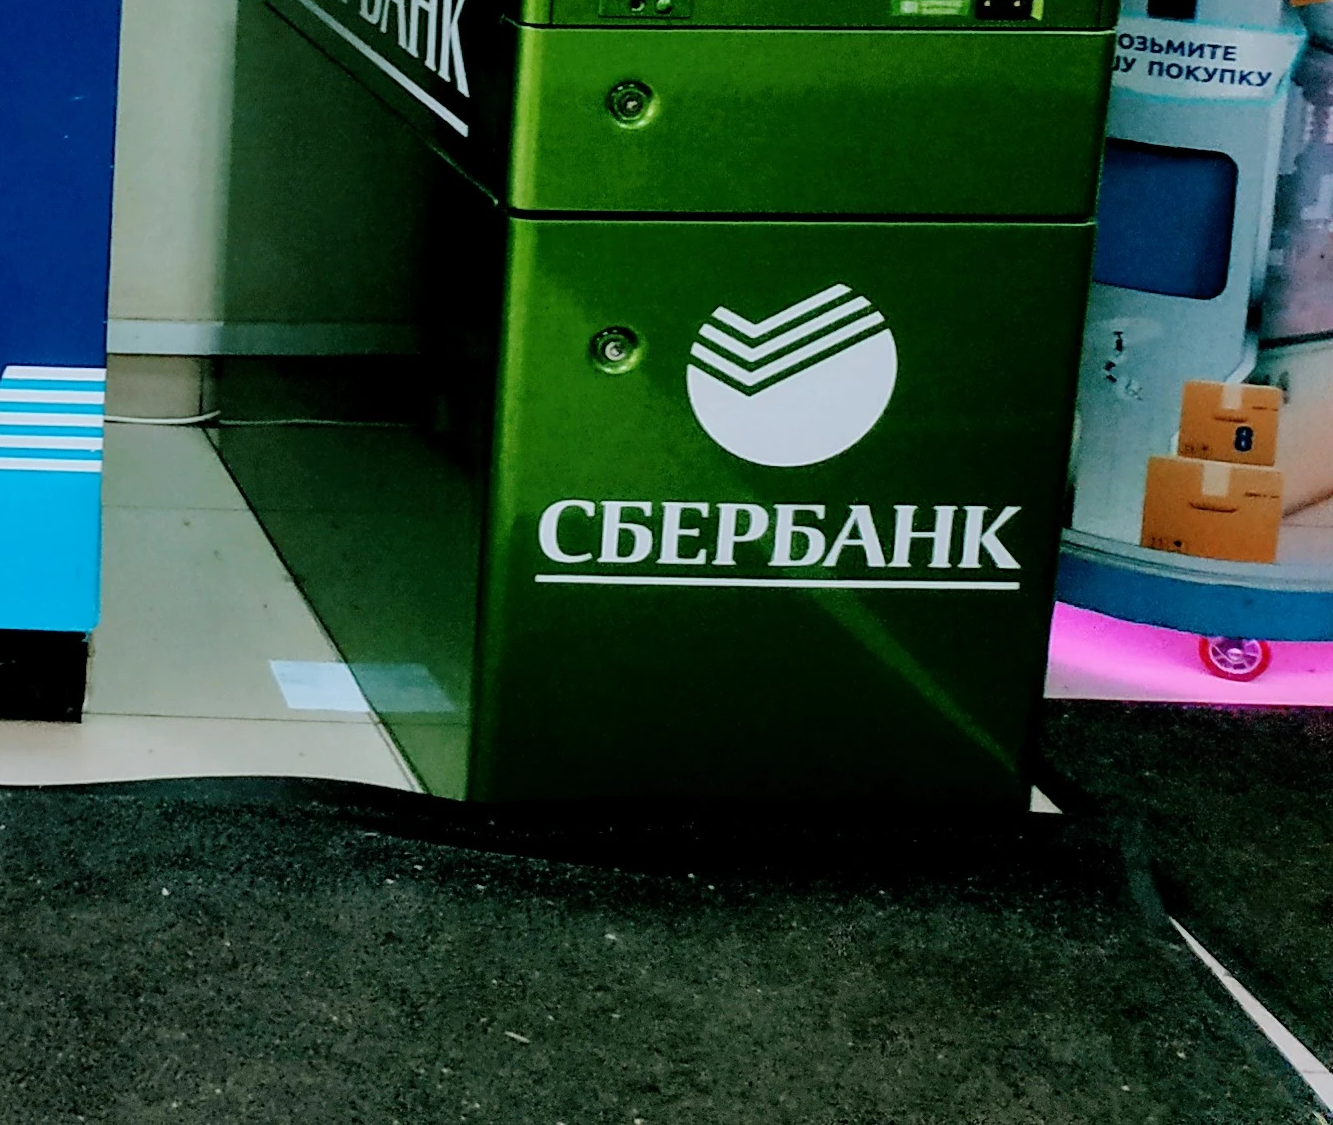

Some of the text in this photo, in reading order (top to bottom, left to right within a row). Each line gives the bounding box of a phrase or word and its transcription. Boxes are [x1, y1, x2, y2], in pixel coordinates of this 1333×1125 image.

[1117, 33, 1238, 62] ОЗЬМИТЕ
[1147, 60, 1273, 87] ПОКУПКУ
[538, 499, 1022, 569] СБЕРБАНК
